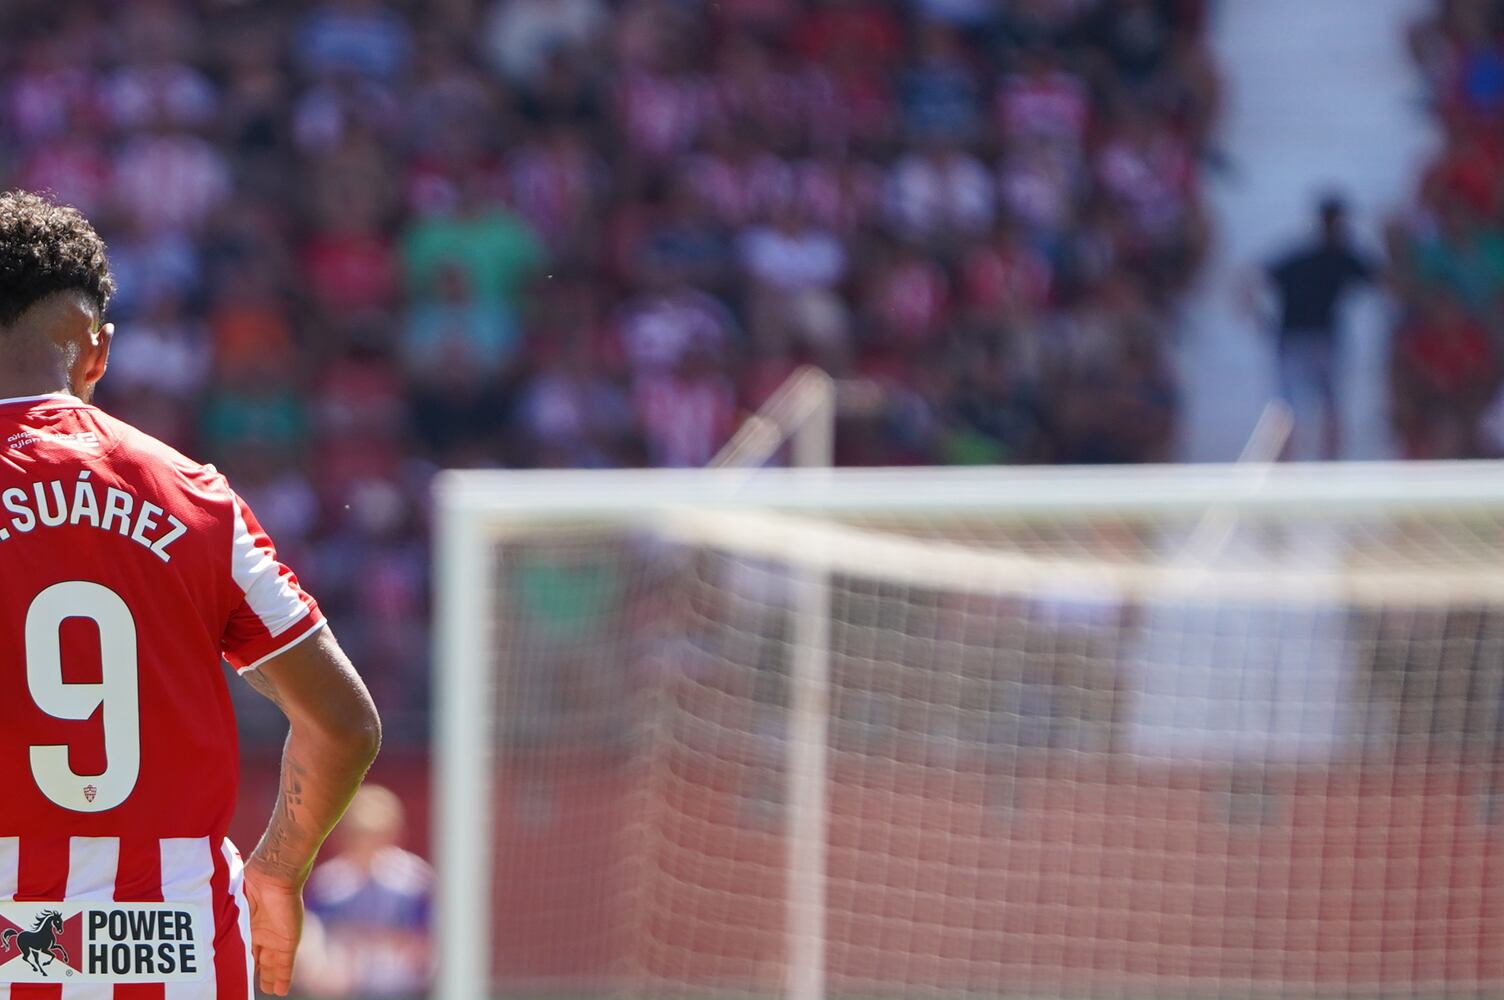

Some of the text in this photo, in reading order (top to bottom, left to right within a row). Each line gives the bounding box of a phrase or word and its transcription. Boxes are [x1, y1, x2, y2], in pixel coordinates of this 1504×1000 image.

[24, 580, 141, 813] 9
[88, 909, 194, 942] POWER
[88, 943, 197, 975] HORSE
